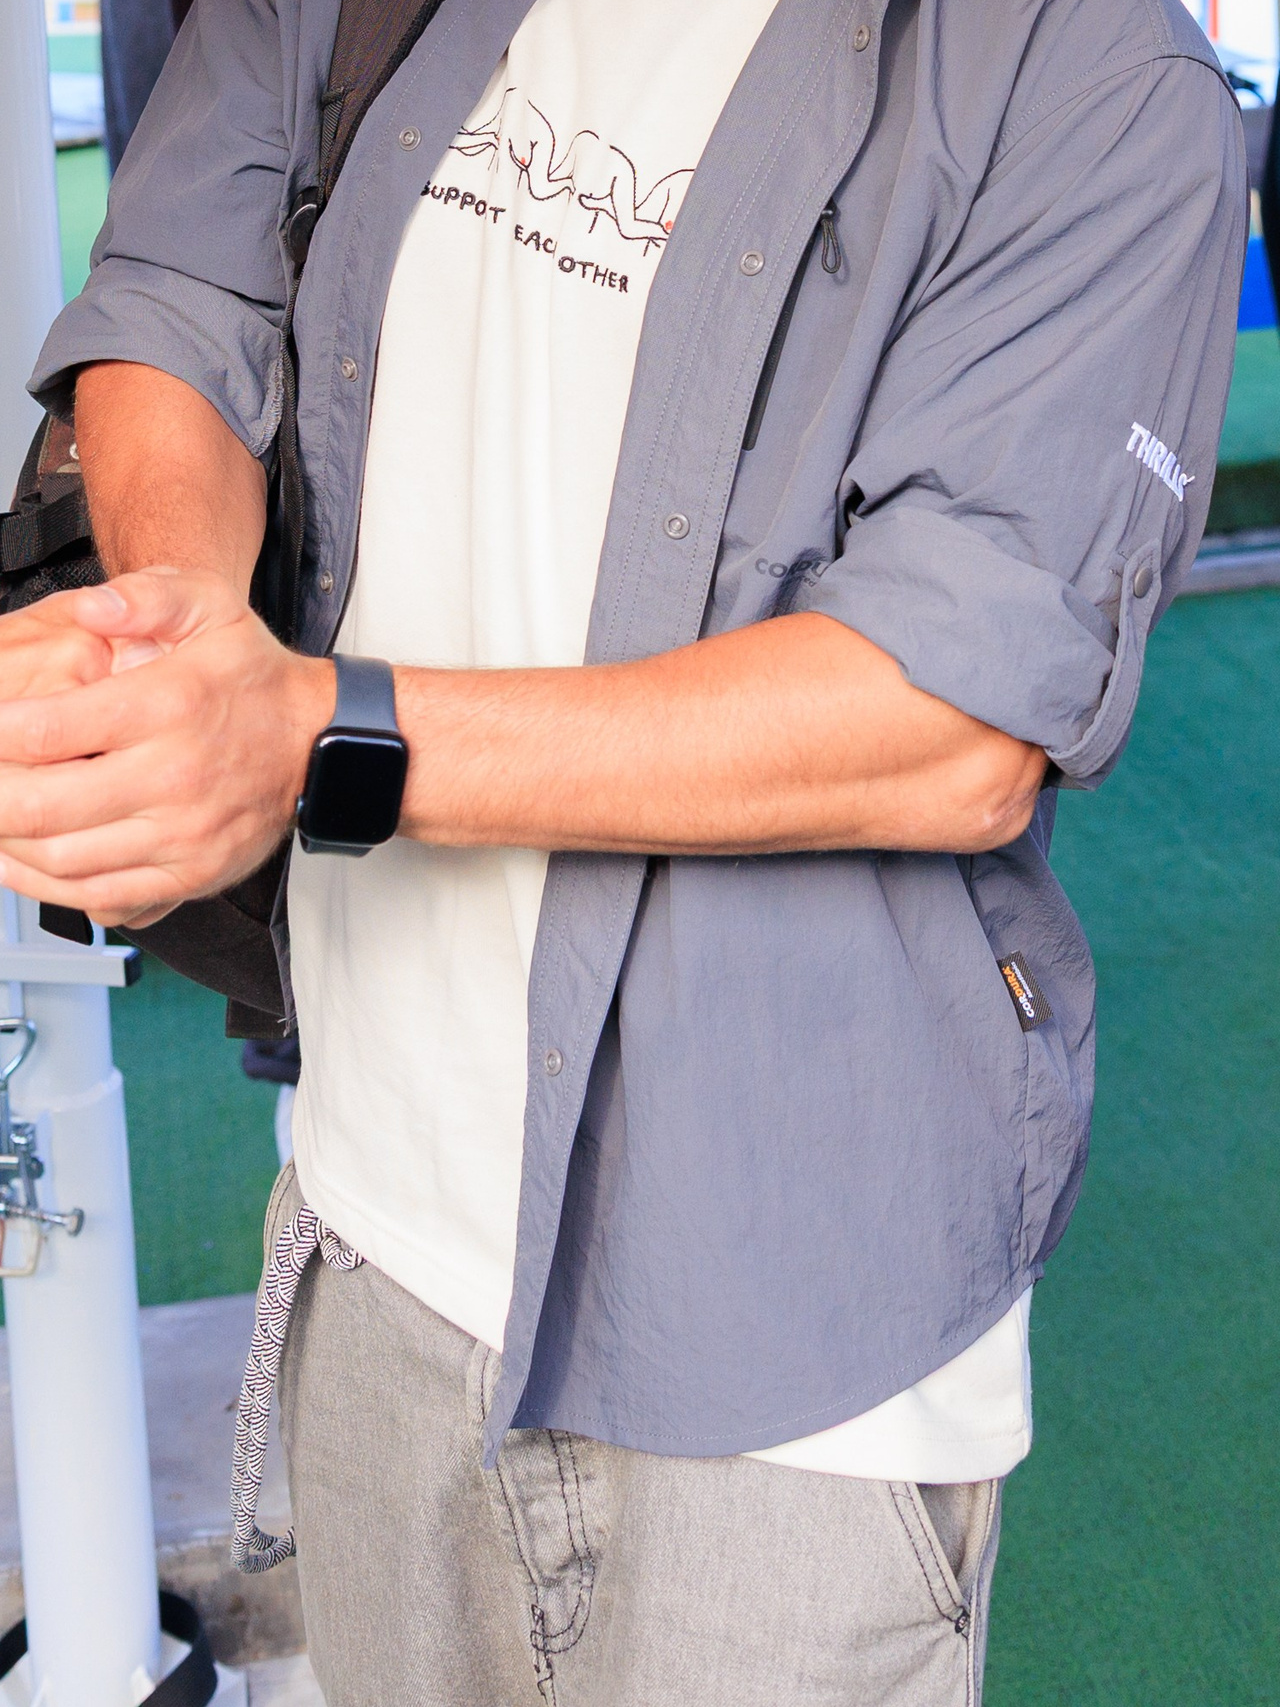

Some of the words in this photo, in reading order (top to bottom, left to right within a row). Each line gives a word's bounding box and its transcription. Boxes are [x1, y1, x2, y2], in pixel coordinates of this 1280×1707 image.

[514, 223, 558, 259] EAC
[558, 255, 629, 293] OTHER
[1003, 965, 1035, 1018] CORDURA
